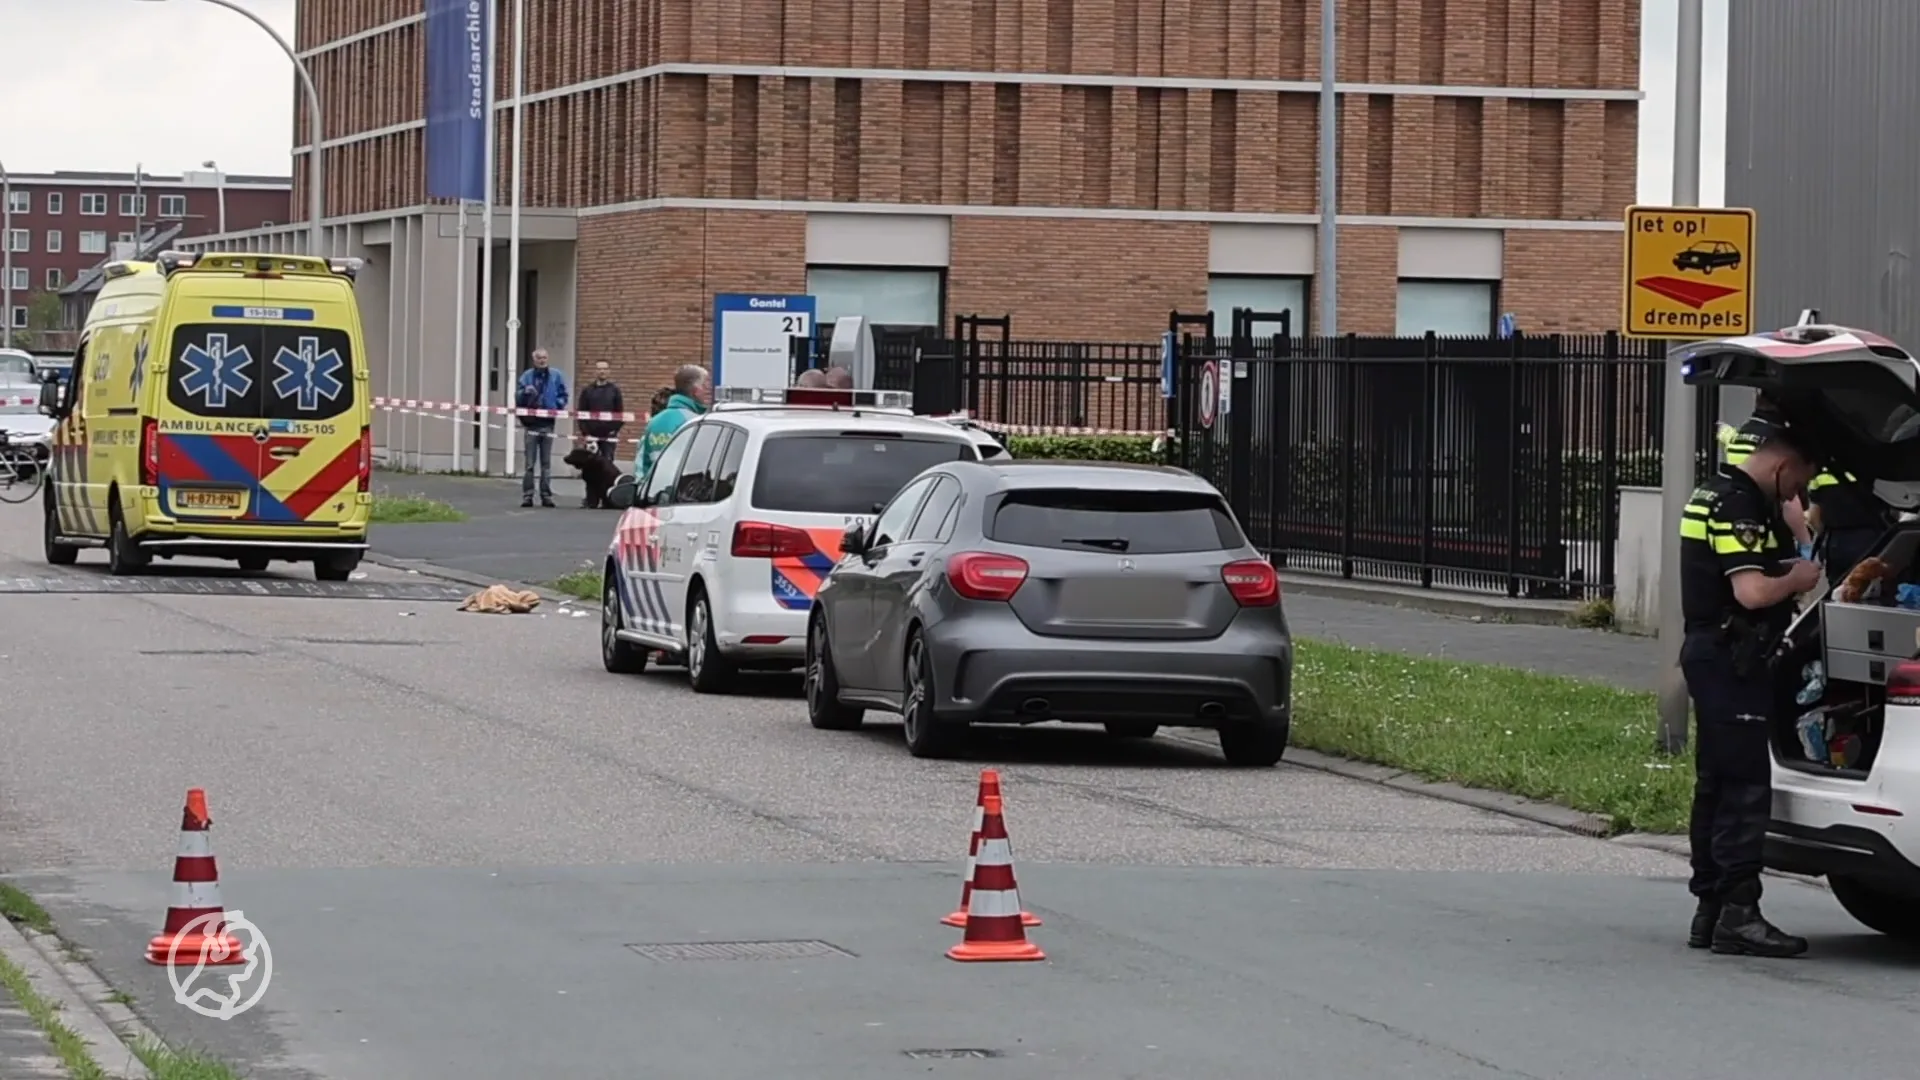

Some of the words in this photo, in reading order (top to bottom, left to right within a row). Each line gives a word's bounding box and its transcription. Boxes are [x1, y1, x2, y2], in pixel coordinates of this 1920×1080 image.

[1637, 215, 1664, 233] let
[1673, 216, 1707, 238] op!
[748, 297, 786, 309] Gantel
[782, 316, 803, 333] 21
[1644, 308, 1743, 330] drempels
[159, 419, 255, 433] AMBULANCE
[296, 424, 336, 435] 15-105
